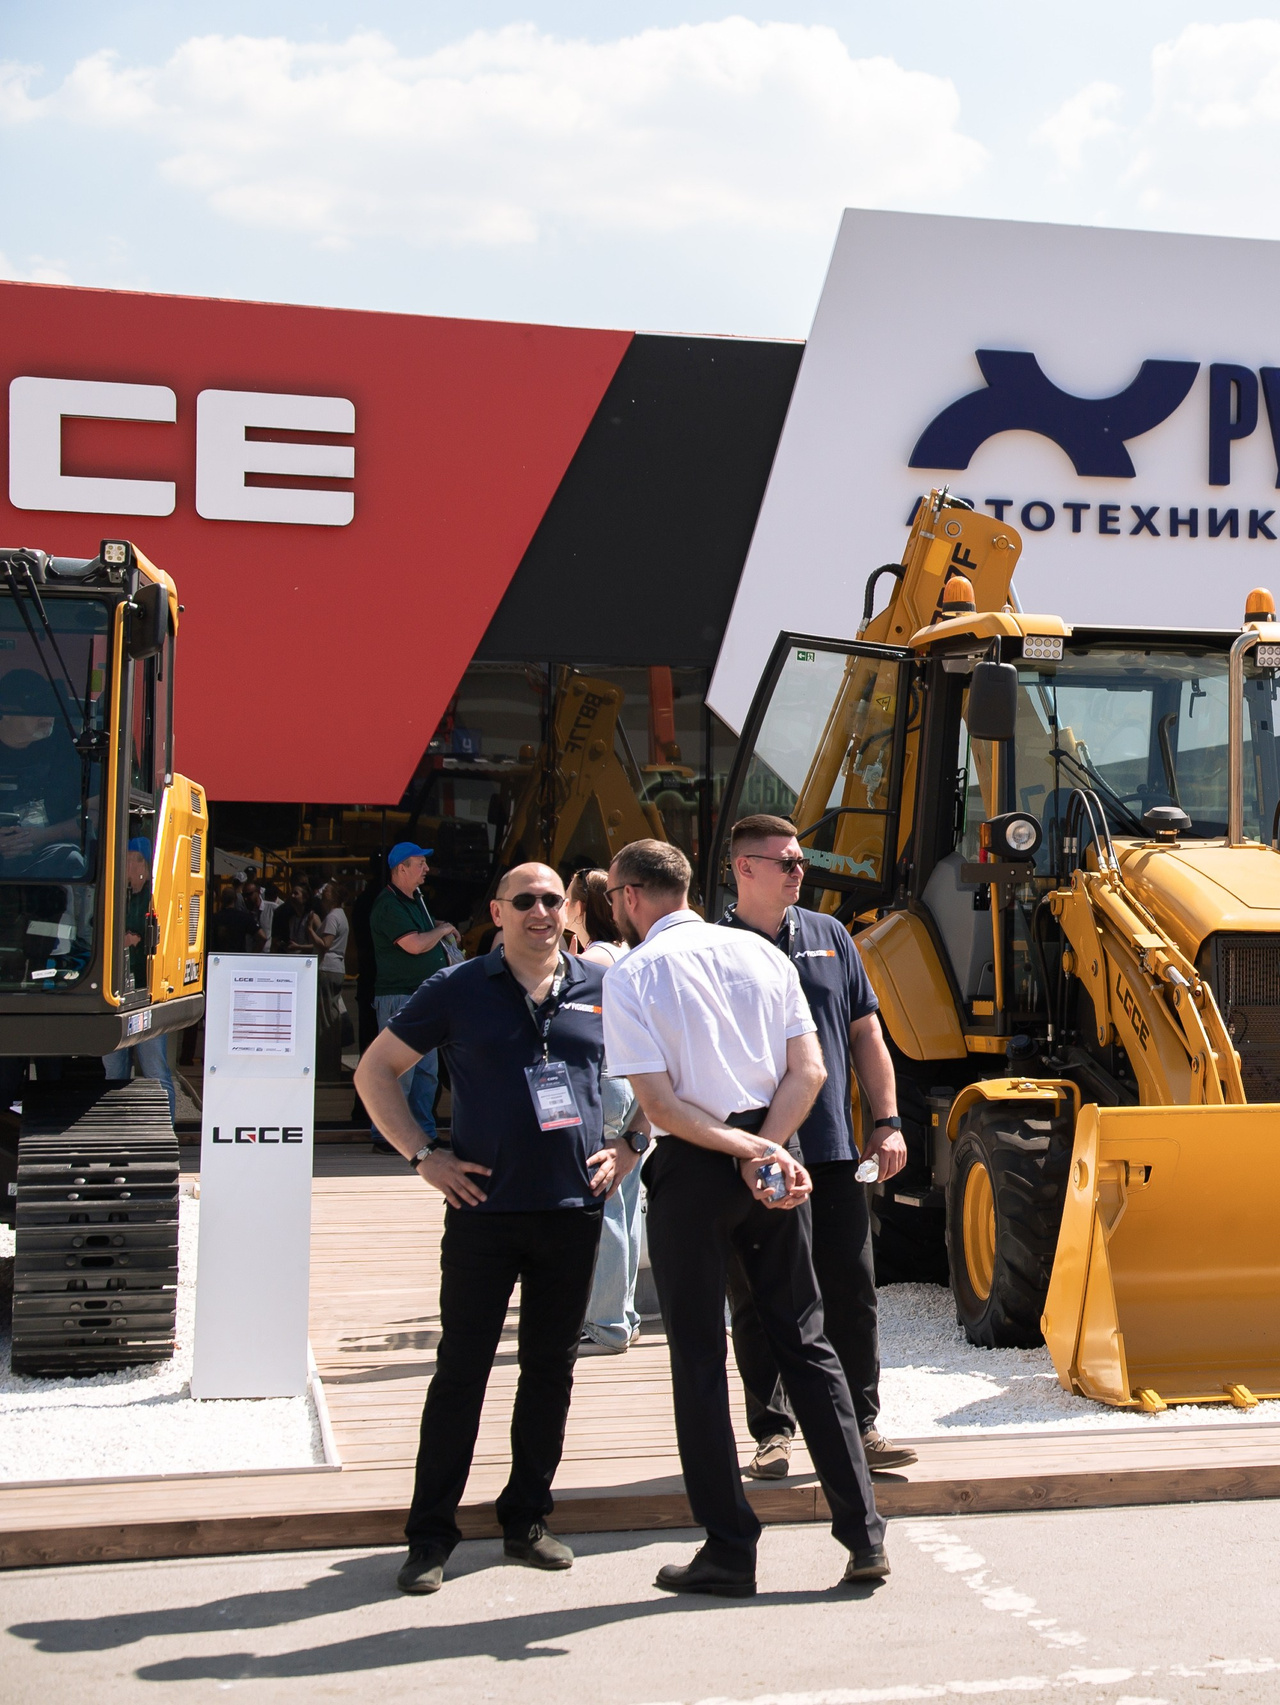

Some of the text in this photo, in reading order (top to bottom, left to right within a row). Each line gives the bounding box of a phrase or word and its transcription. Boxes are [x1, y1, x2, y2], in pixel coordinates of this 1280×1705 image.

[9, 376, 356, 526] CE
[1116, 973, 1150, 1052] LGCE
[212, 1127, 303, 1144] LGCE
